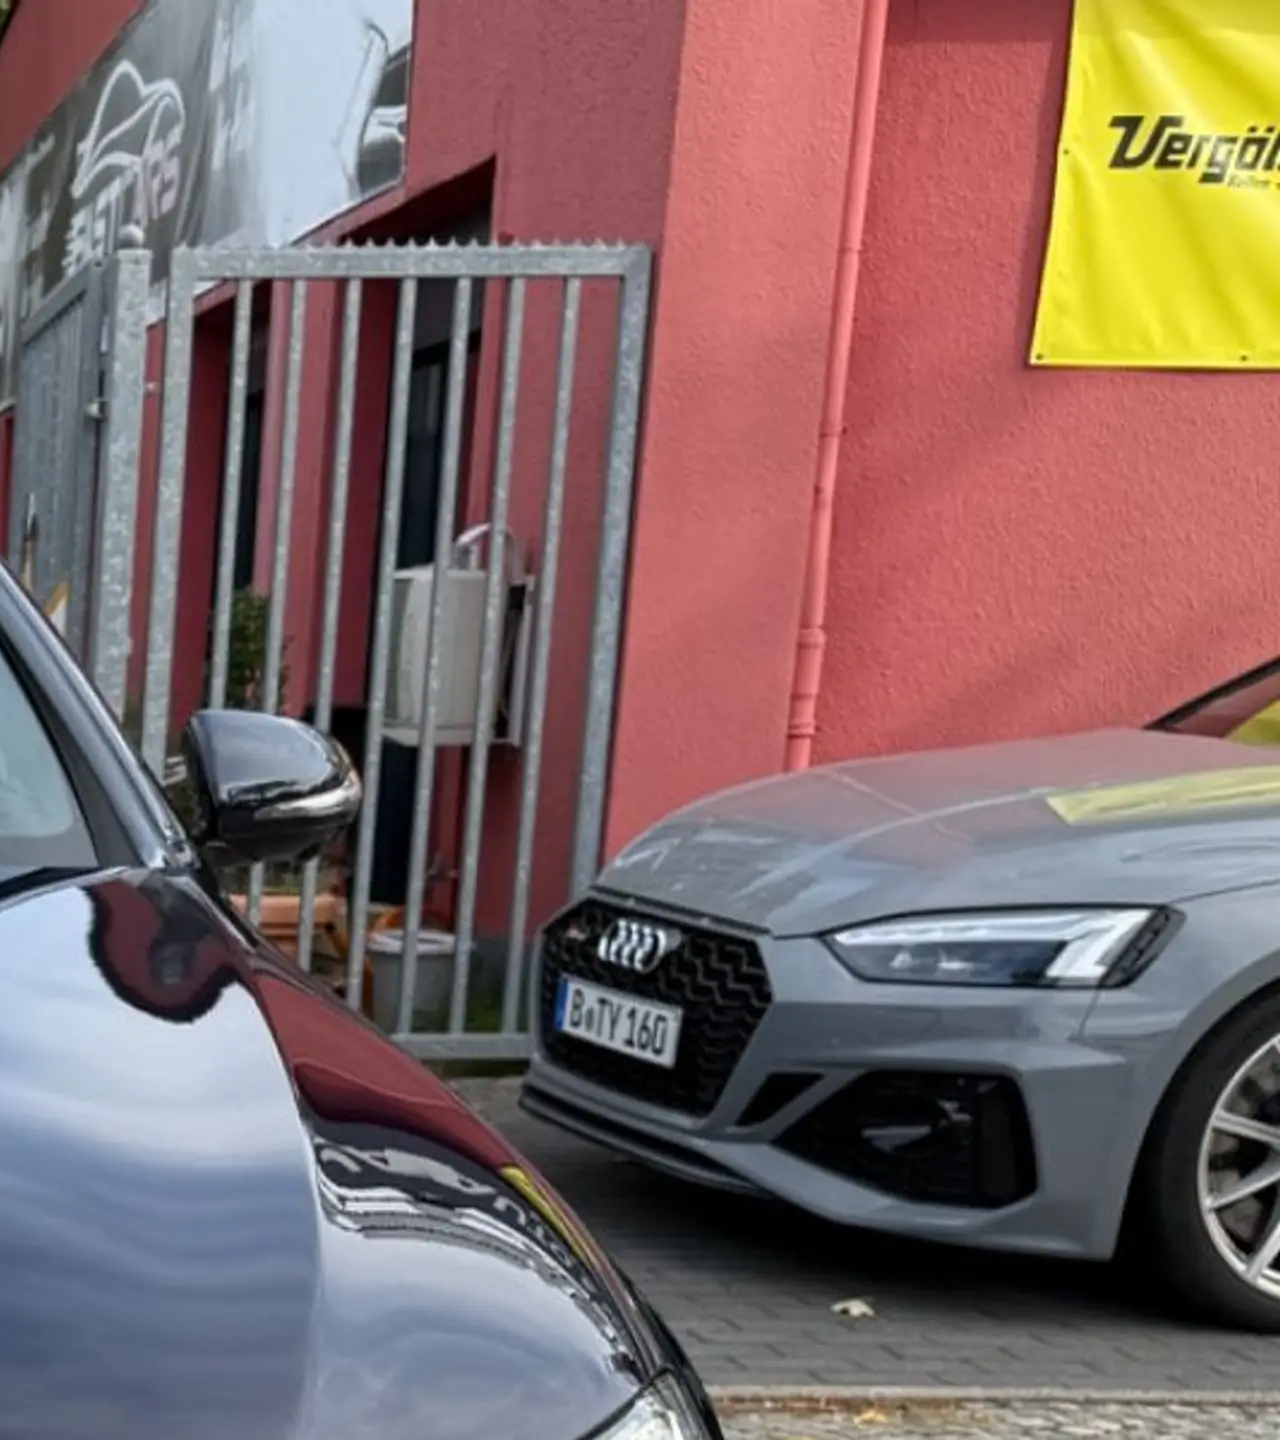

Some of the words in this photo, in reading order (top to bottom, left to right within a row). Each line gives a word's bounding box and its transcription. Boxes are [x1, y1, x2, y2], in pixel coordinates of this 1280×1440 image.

[1107, 115, 1280, 184] Vergöl
[570, 988, 586, 1028] B
[596, 997, 622, 1041] TY
[623, 1007, 668, 1056] 160
